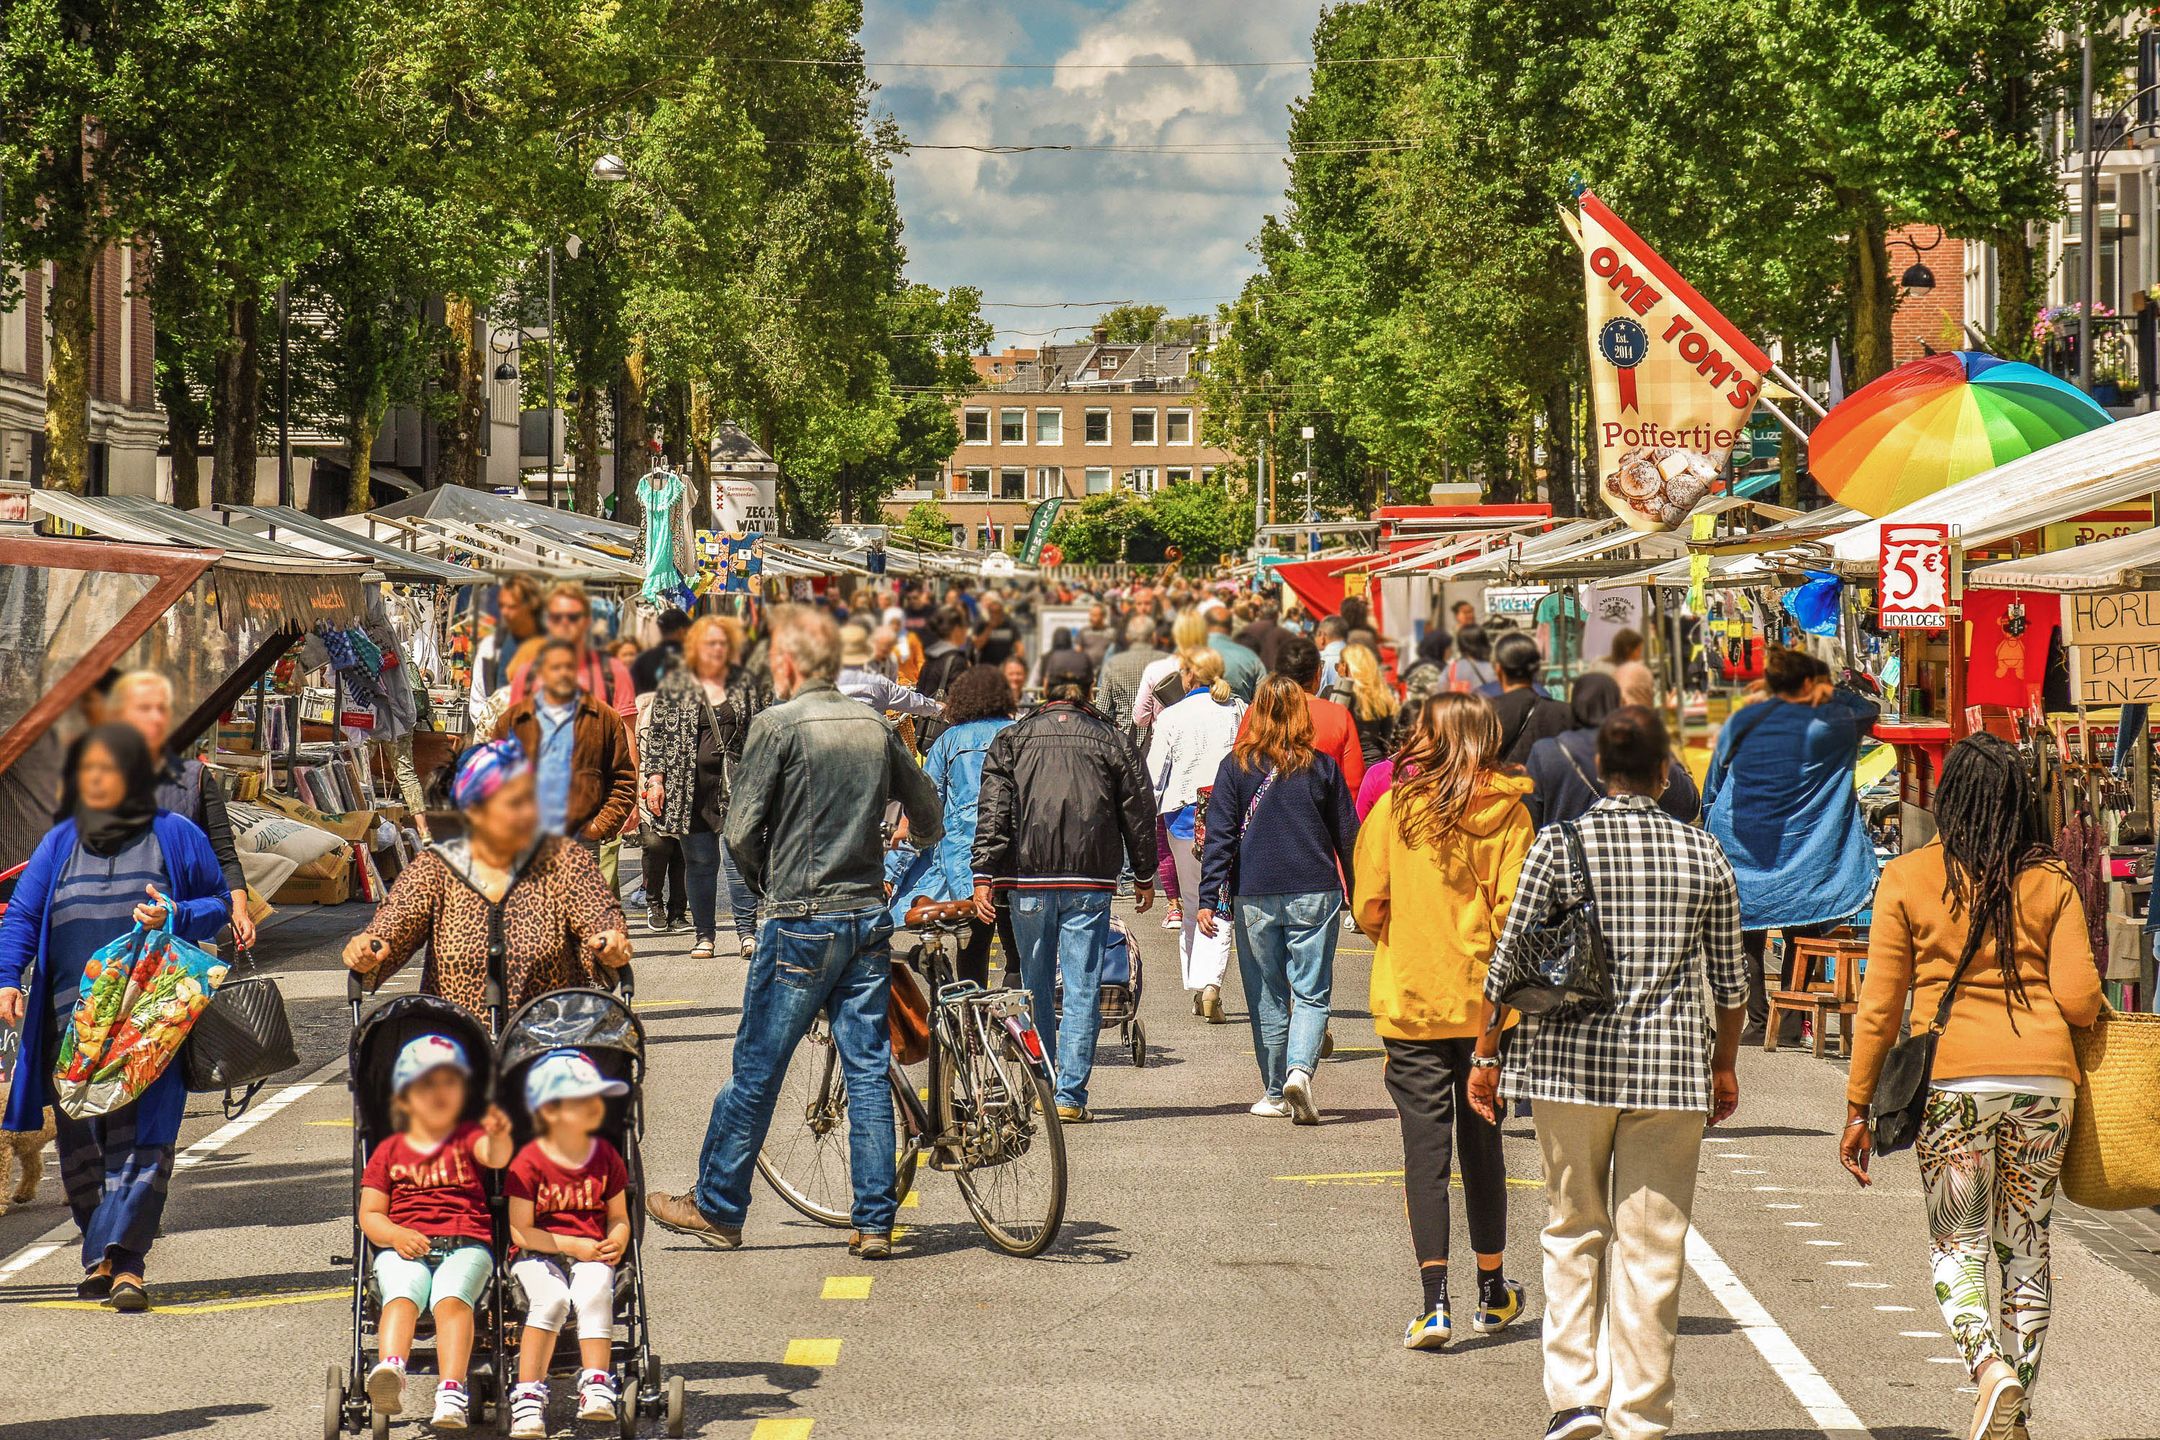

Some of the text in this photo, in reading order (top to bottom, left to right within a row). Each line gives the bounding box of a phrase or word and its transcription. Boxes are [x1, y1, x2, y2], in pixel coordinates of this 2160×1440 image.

[1590, 247, 1758, 409] OME TOM'S
[1615, 333, 1629, 343] Est.
[1614, 345, 1633, 359] 2014
[746, 506, 766, 518] ZEG
[736, 520, 760, 532] WAT
[1026, 501, 1054, 564] BLOEMEN
[2075, 593, 2160, 632] HORL
[1885, 614, 1945, 626] HORLOGES
[2083, 677, 2158, 702] INZ
